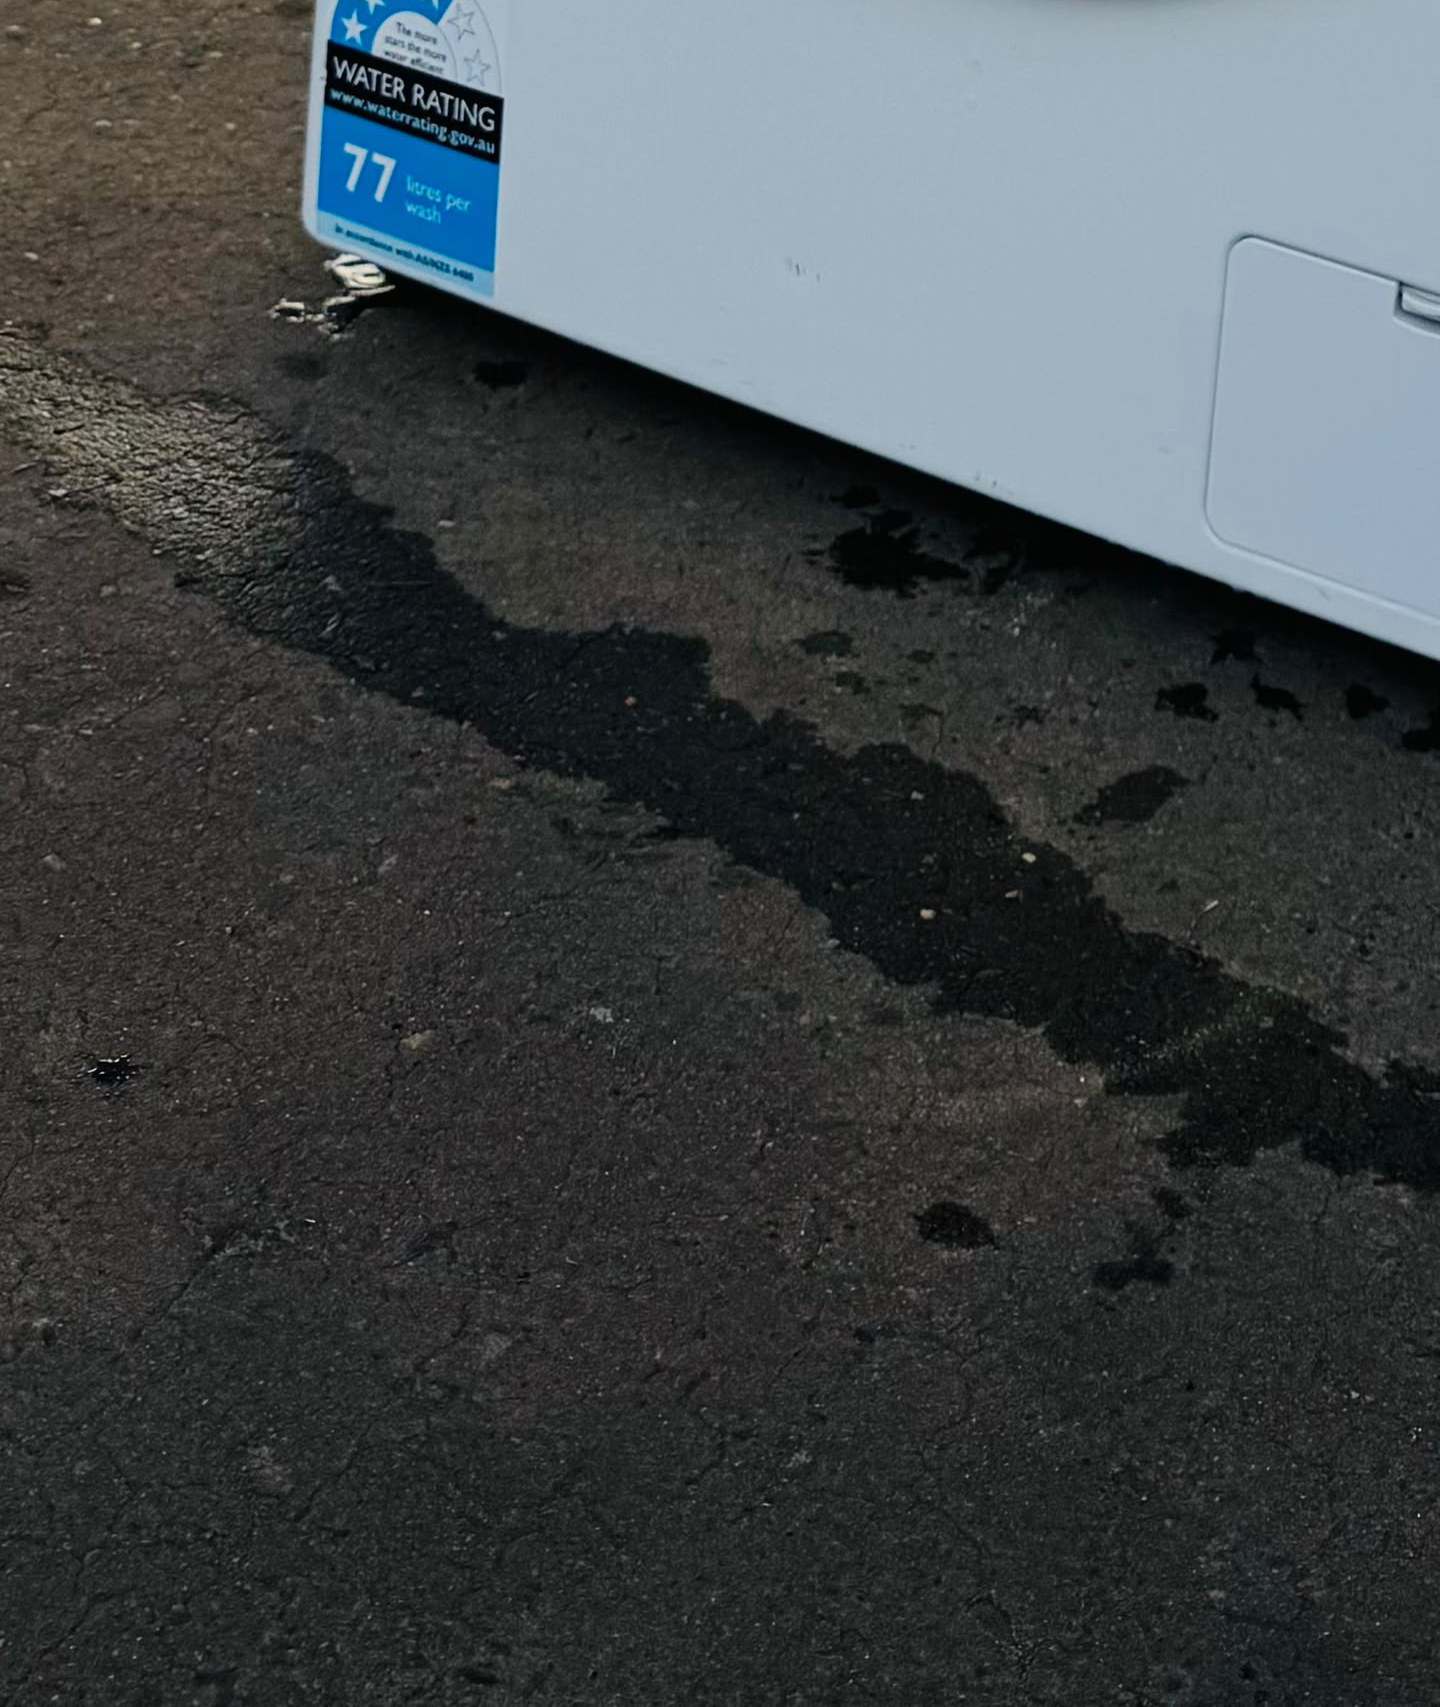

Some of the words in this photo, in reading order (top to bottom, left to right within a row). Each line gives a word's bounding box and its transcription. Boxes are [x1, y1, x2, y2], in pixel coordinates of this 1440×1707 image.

[330, 88, 495, 155] www.waterrating.gov.au
[332, 55, 407, 103] WATER
[411, 83, 496, 132] RATING
[344, 141, 397, 203] 77
[406, 174, 442, 203] litres
[445, 193, 472, 212] per
[405, 201, 442, 224] wash
